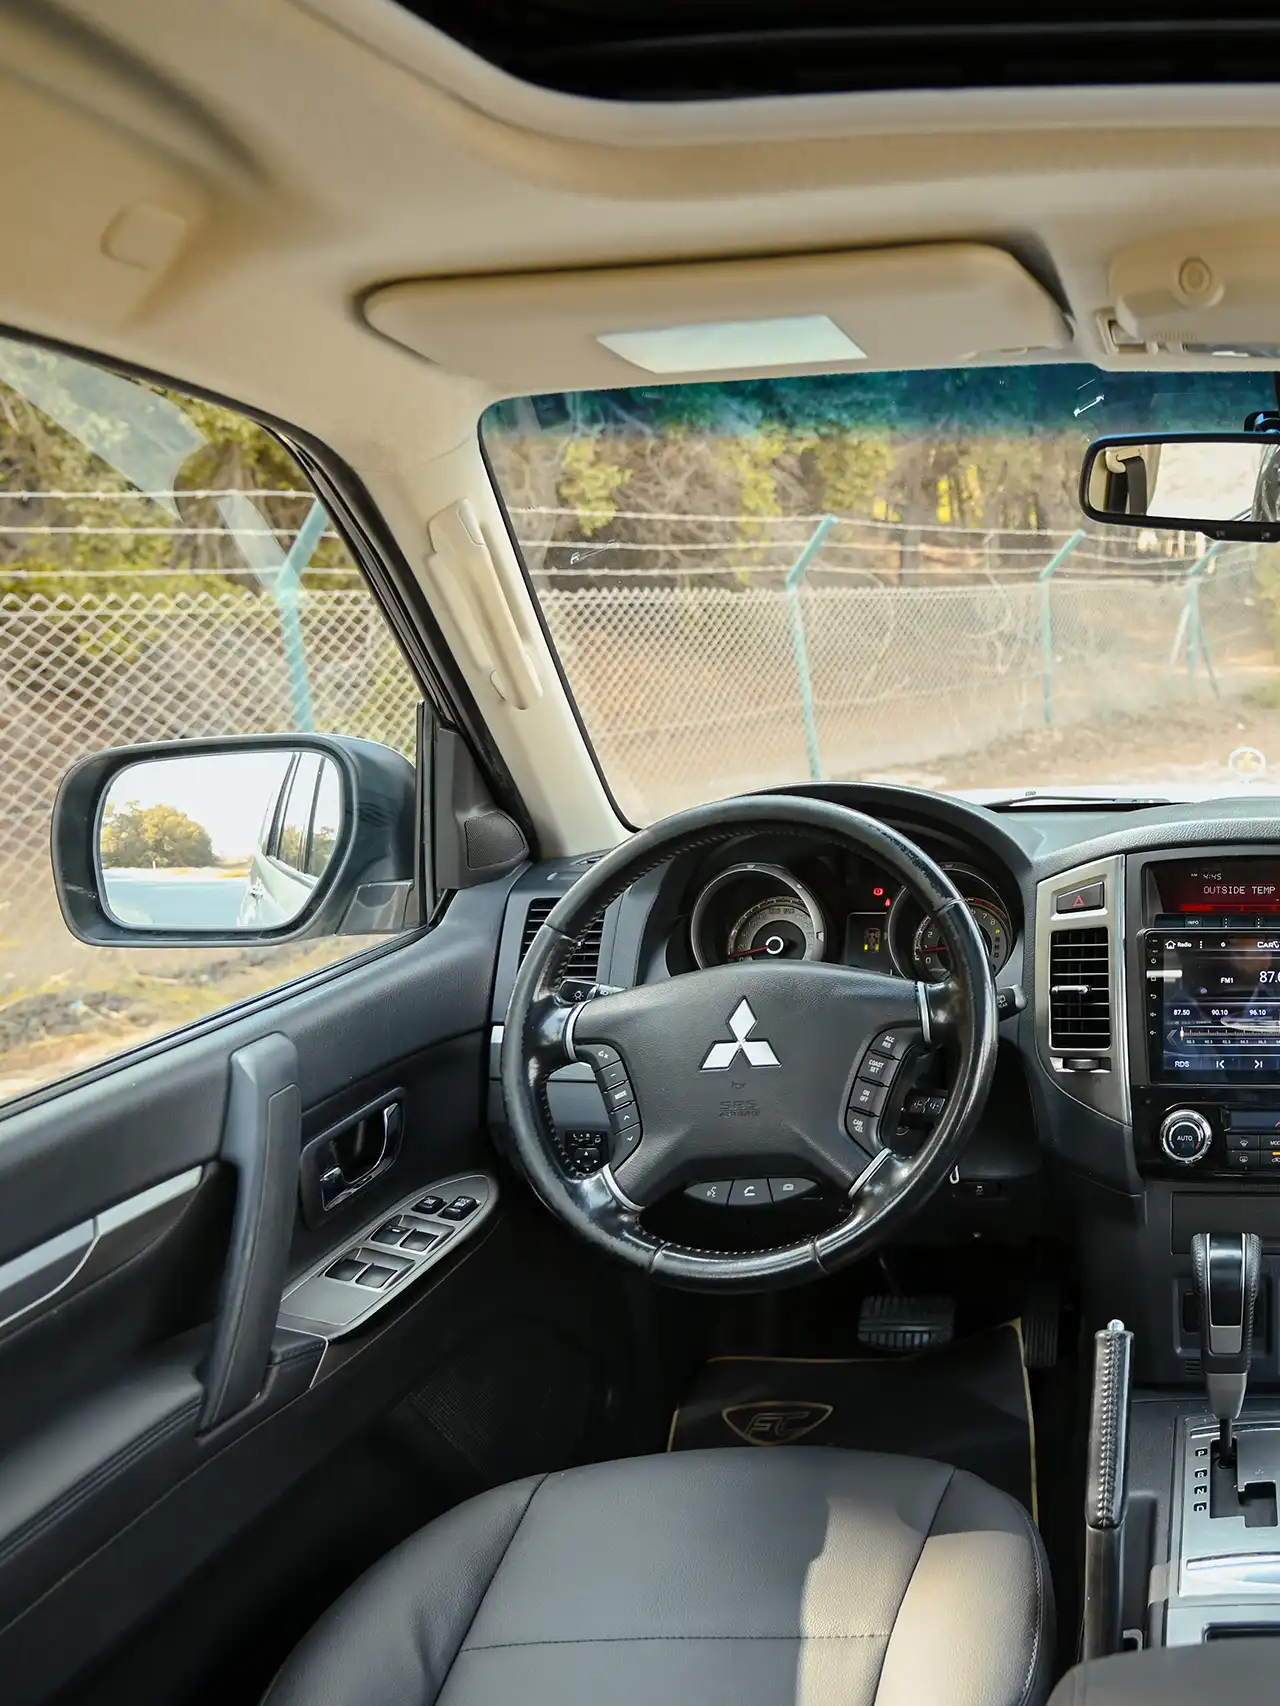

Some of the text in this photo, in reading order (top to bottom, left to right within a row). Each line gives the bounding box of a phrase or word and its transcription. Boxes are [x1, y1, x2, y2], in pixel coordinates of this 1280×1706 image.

[1202, 872, 1222, 881] 4:45
[1203, 885, 1276, 895] OUTSIDE TEMP
[868, 1059, 885, 1069] COAST
[1174, 1060, 1190, 1068] RDS
[869, 1066, 880, 1074] SET
